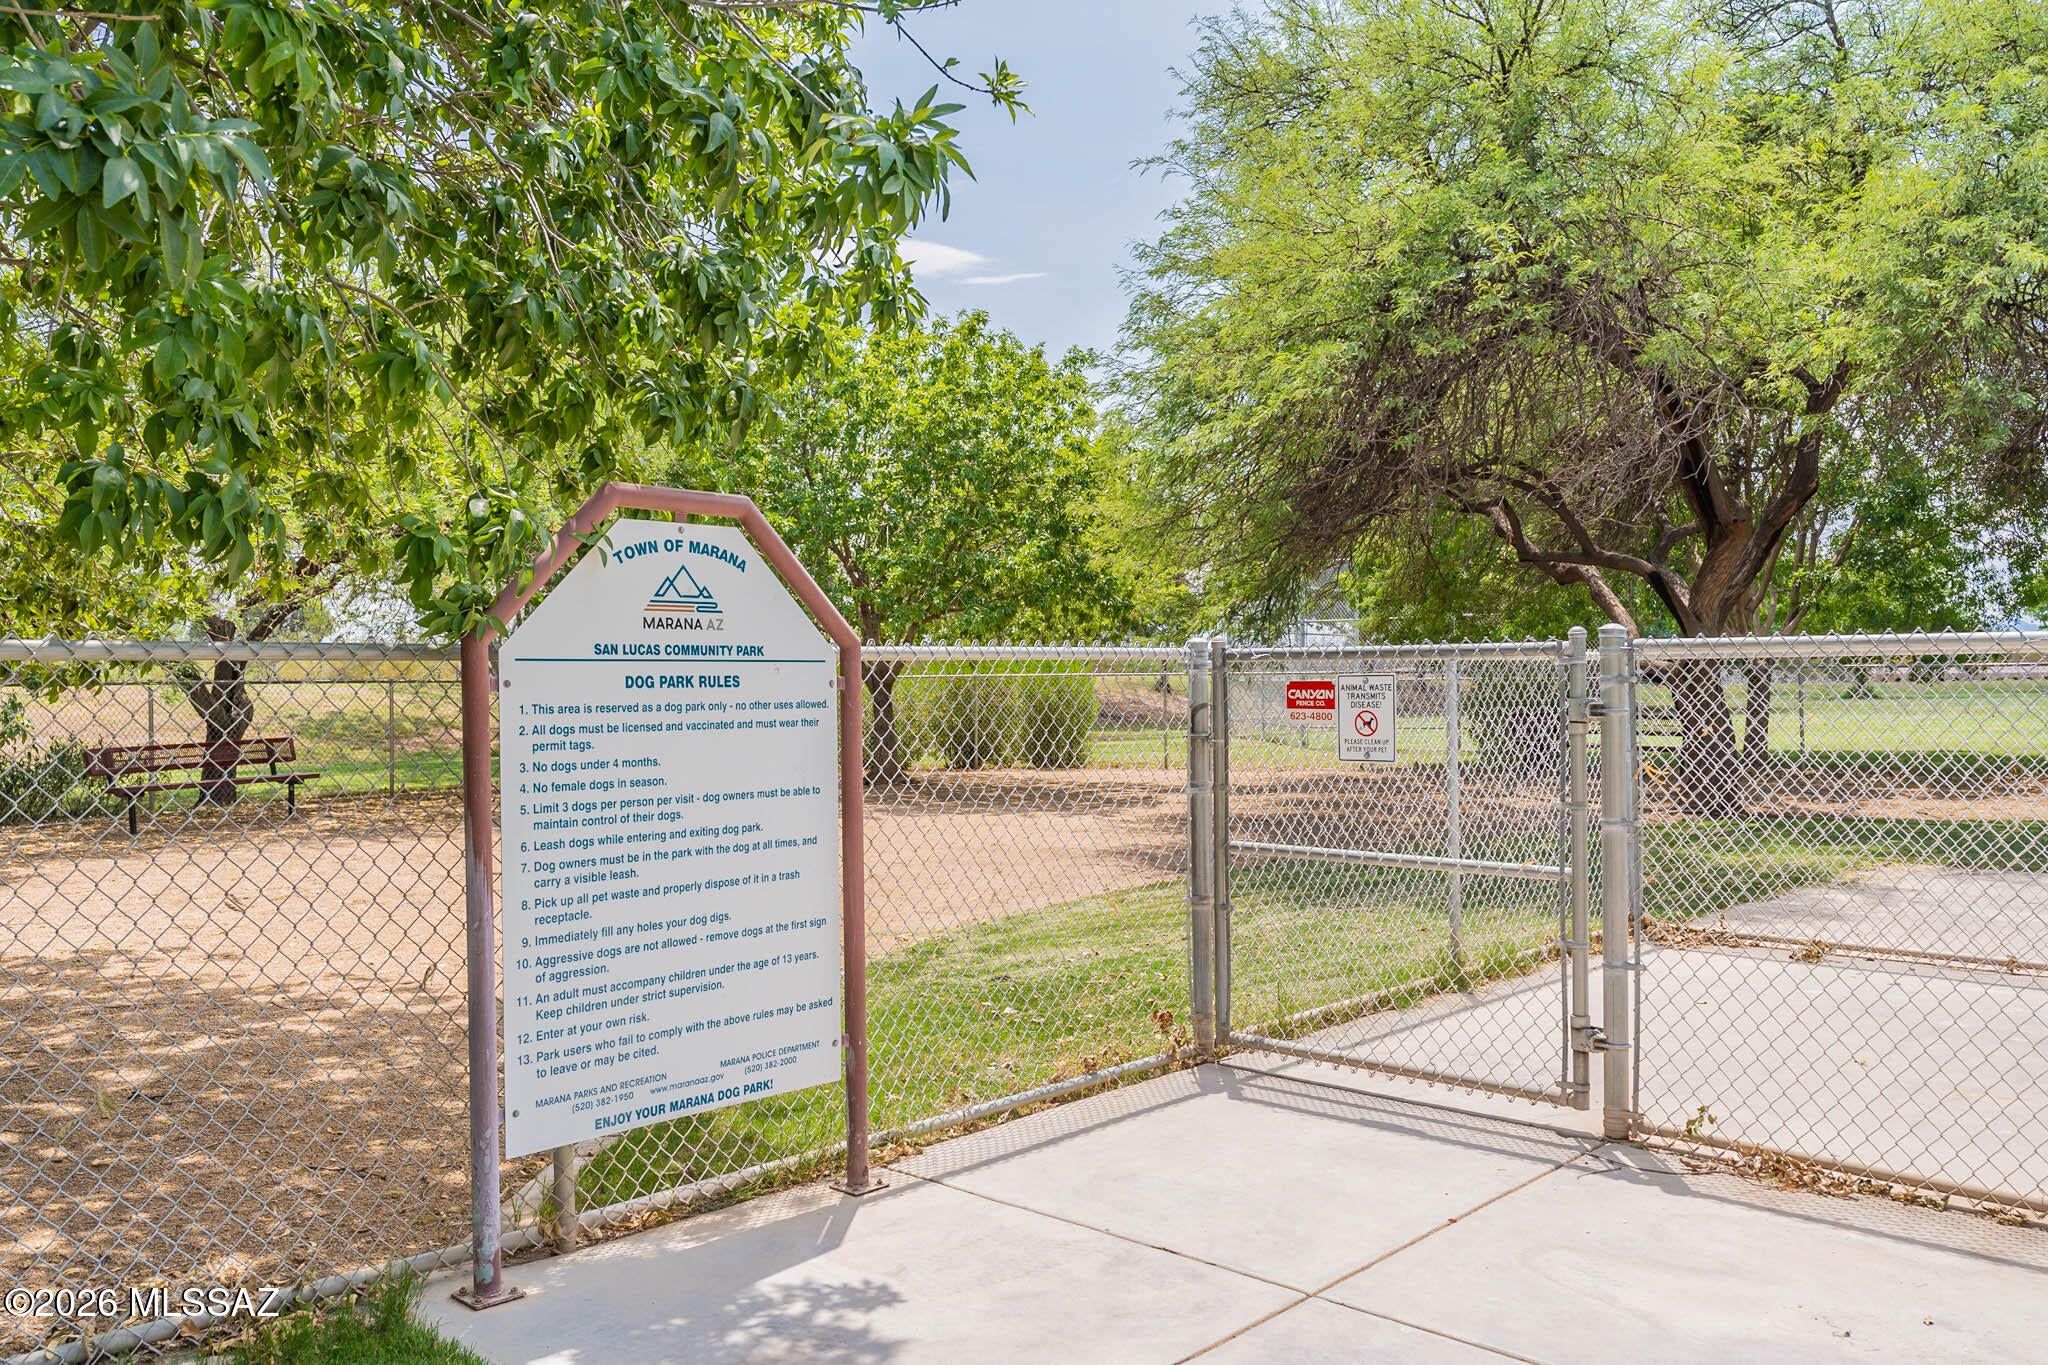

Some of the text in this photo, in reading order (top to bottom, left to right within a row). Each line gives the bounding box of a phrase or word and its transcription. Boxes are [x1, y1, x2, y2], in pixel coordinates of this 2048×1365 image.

[612, 539, 746, 573] TOWN OF MARANA
[643, 617, 724, 631] MARANA AZ
[594, 643, 765, 657] SAN LUCAS COMMUNITY PARK
[625, 674, 741, 689] DOG PARK RULES
[1341, 683, 1392, 692] ANIMAL WASTE
[1288, 689, 1334, 700] CANYON
[1346, 692, 1386, 700] TRANSMITS
[1350, 700, 1382, 709] DISEASE!
[519, 704, 529, 715] 1.
[531, 703, 555, 715] This
[557, 705, 581, 715] area
[583, 703, 593, 714] is
[595, 702, 639, 714] reserved
[641, 704, 654, 713] as
[655, 704, 662, 712] a
[664, 701, 683, 714] dog
[685, 701, 706, 714] park
[708, 701, 728, 713] only
[735, 702, 747, 711] no
[748, 700, 772, 710] other
[773, 701, 794, 710] uses
[795, 699, 829, 709] allowed.
[1290, 711, 1333, 720] 623-4800
[518, 717, 820, 737] 2. All dogs must be licensed and vaccinated and must wear their
[532, 740, 595, 755] permit tags.
[519, 756, 661, 774] 3. No dogs under 4 months.
[519, 778, 667, 794] 4. No female dogs in season.
[520, 822, 763, 853] 6. Leash dogs while entering and exiting dog park.
[533, 868, 639, 889] carry a visible leash.
[521, 912, 732, 949] 9. Immediately fill any holes your dog digs.
[516, 951, 819, 1007] 11. An adult must accompany children under the age of 13 years.
[536, 981, 725, 1021] Keep children under strict supervision.
[517, 1012, 650, 1045] 12. Enter at your own risk.
[517, 996, 833, 1066] 13. Park users who fail to comply with the above rules may be asked
[536, 1045, 659, 1079] to leave or may be cited.
[720, 1040, 820, 1068] MARANA POLICE DEPARTMENT
[744, 1055, 797, 1076] (520) 382-2000
[535, 1072, 667, 1108] MARANA PARKS AND RECREATION
[650, 1073, 724, 1095] www.maranaaz.gov
[572, 1091, 634, 1114] (520) 382-1950
[595, 1078, 773, 1130] ENJOY YOUR MARANA DOG PARK!
